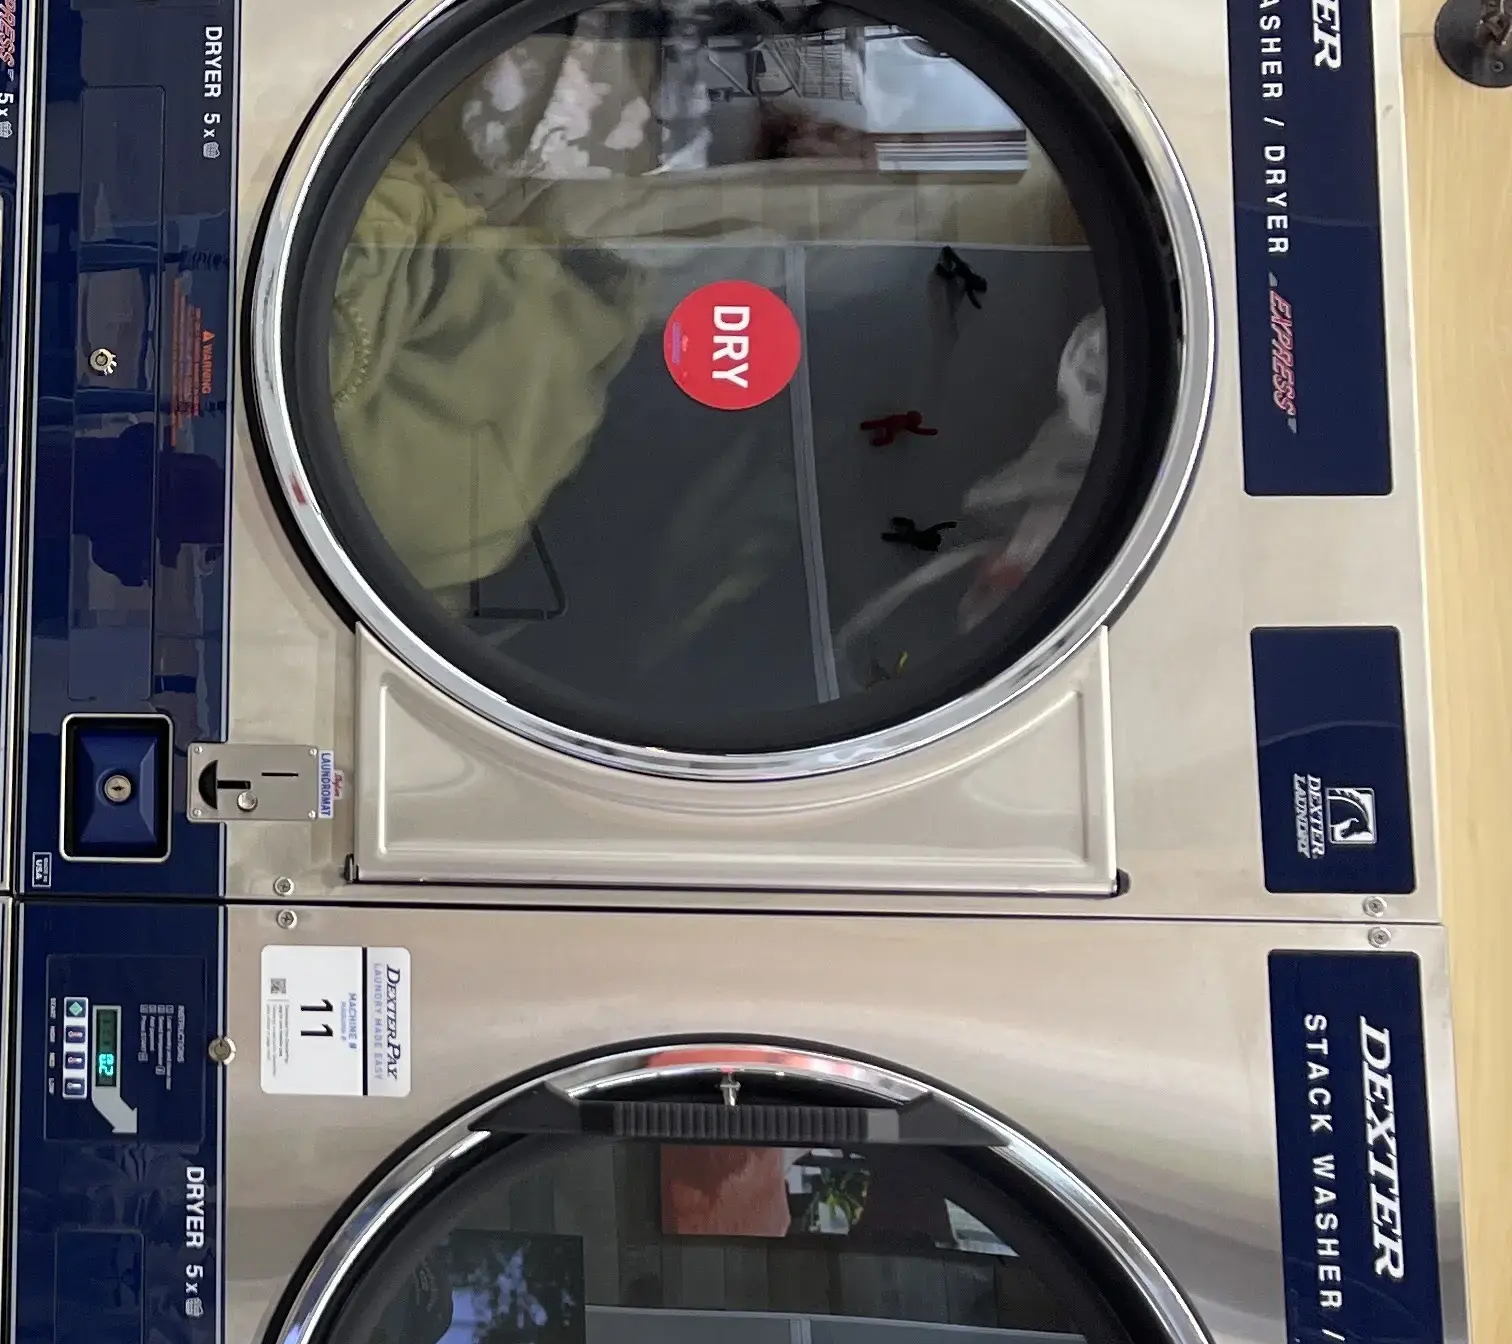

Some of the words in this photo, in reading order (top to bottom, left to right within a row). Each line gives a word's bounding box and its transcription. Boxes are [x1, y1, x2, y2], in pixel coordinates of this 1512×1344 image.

[204, 26, 222, 97] DRYER
[203, 112, 220, 124] 5
[203, 128, 215, 138] x
[1263, 117, 1286, 126] /
[1264, 146, 1290, 255] DRYER
[202, 345, 212, 394] WARNING
[712, 306, 750, 389] DRY
[1269, 289, 1296, 416] EXPRESS
[321, 753, 331, 816] LAUNDROMAT
[1293, 773, 1311, 858] LAUNDRY
[1308, 775, 1325, 858] DEXTER
[35, 860, 43, 879] USA
[300, 999, 334, 1037] 11
[1303, 1013, 1333, 1134] STACK
[1359, 1015, 1405, 1280] DEXTER
[185, 1167, 204, 1248] DRYER
[1312, 1155, 1343, 1309] WASHER
[185, 1264, 203, 1278] 5
[185, 1282, 198, 1294] x
[1320, 1329, 1345, 1341] /
